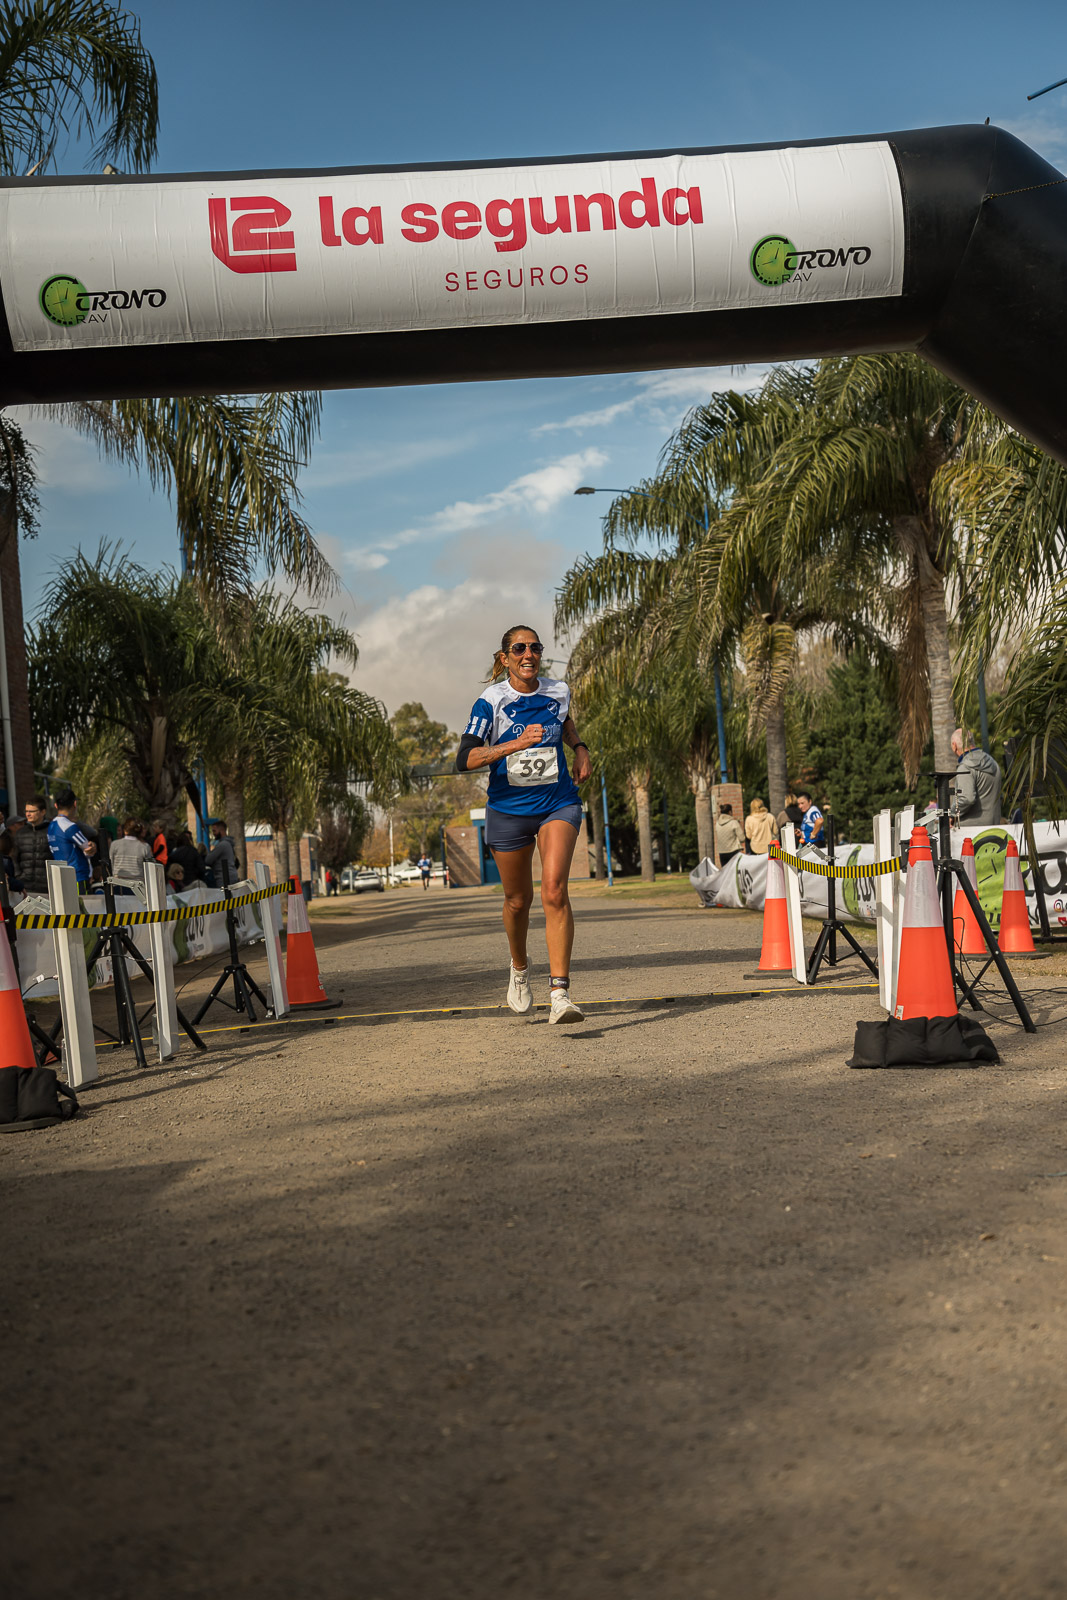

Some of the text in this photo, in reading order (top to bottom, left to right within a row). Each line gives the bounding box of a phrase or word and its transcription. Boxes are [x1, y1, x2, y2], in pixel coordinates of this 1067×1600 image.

[318, 176, 704, 253] la segunda
[784, 245, 872, 271] CRONO
[445, 263, 589, 292] SEGUROS
[781, 272, 812, 284] RAV
[76, 288, 167, 312] CRONO
[76, 313, 108, 325] RAV
[520, 758, 546, 778] 39
